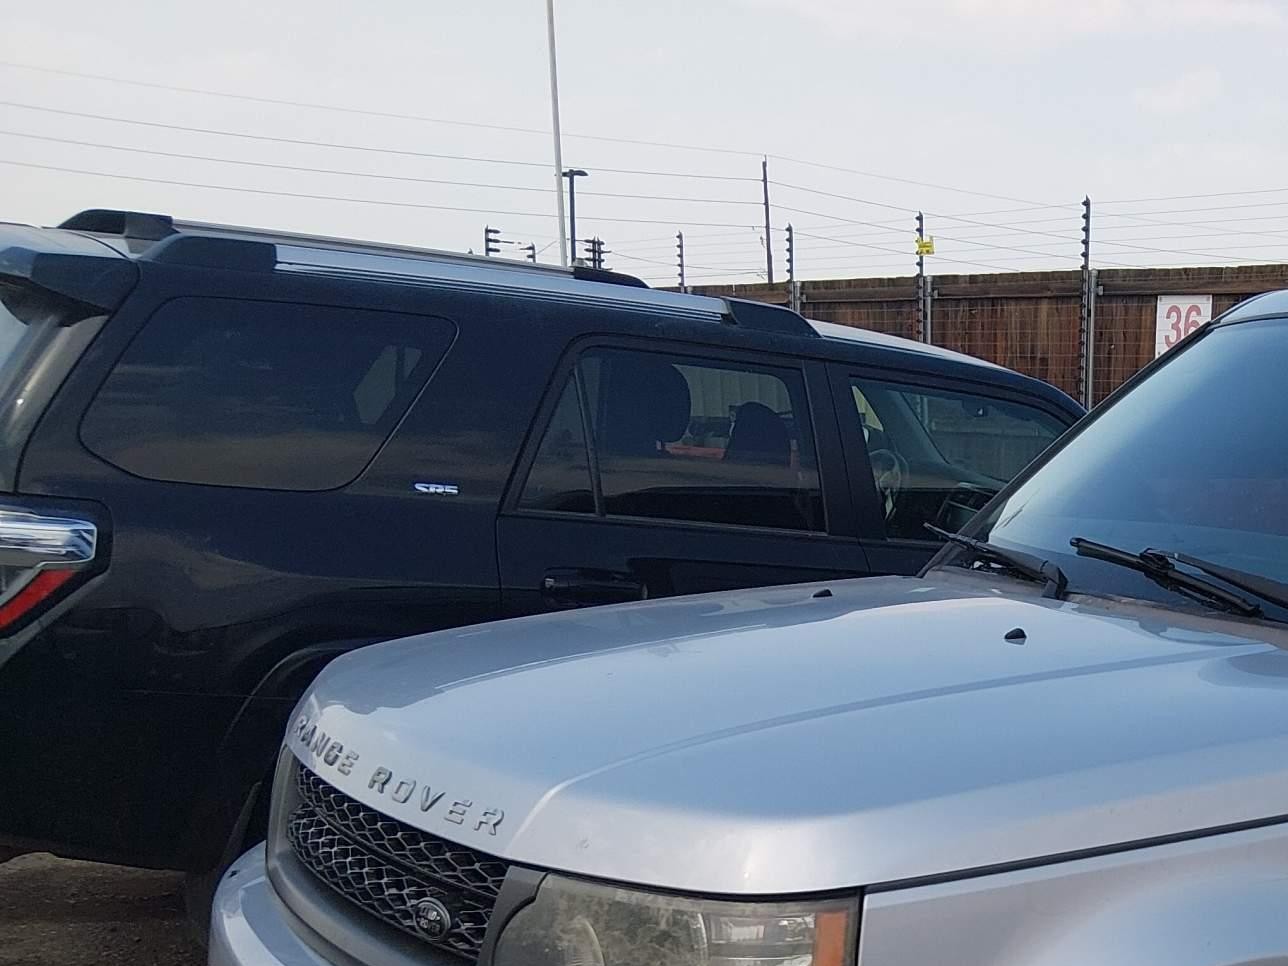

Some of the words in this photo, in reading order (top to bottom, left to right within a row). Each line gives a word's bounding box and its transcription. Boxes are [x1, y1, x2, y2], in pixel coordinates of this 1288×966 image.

[1164, 304, 1202, 349] 36
[414, 482, 459, 496] SR5
[294, 715, 360, 776] RANGE
[367, 765, 505, 836] ROVER
